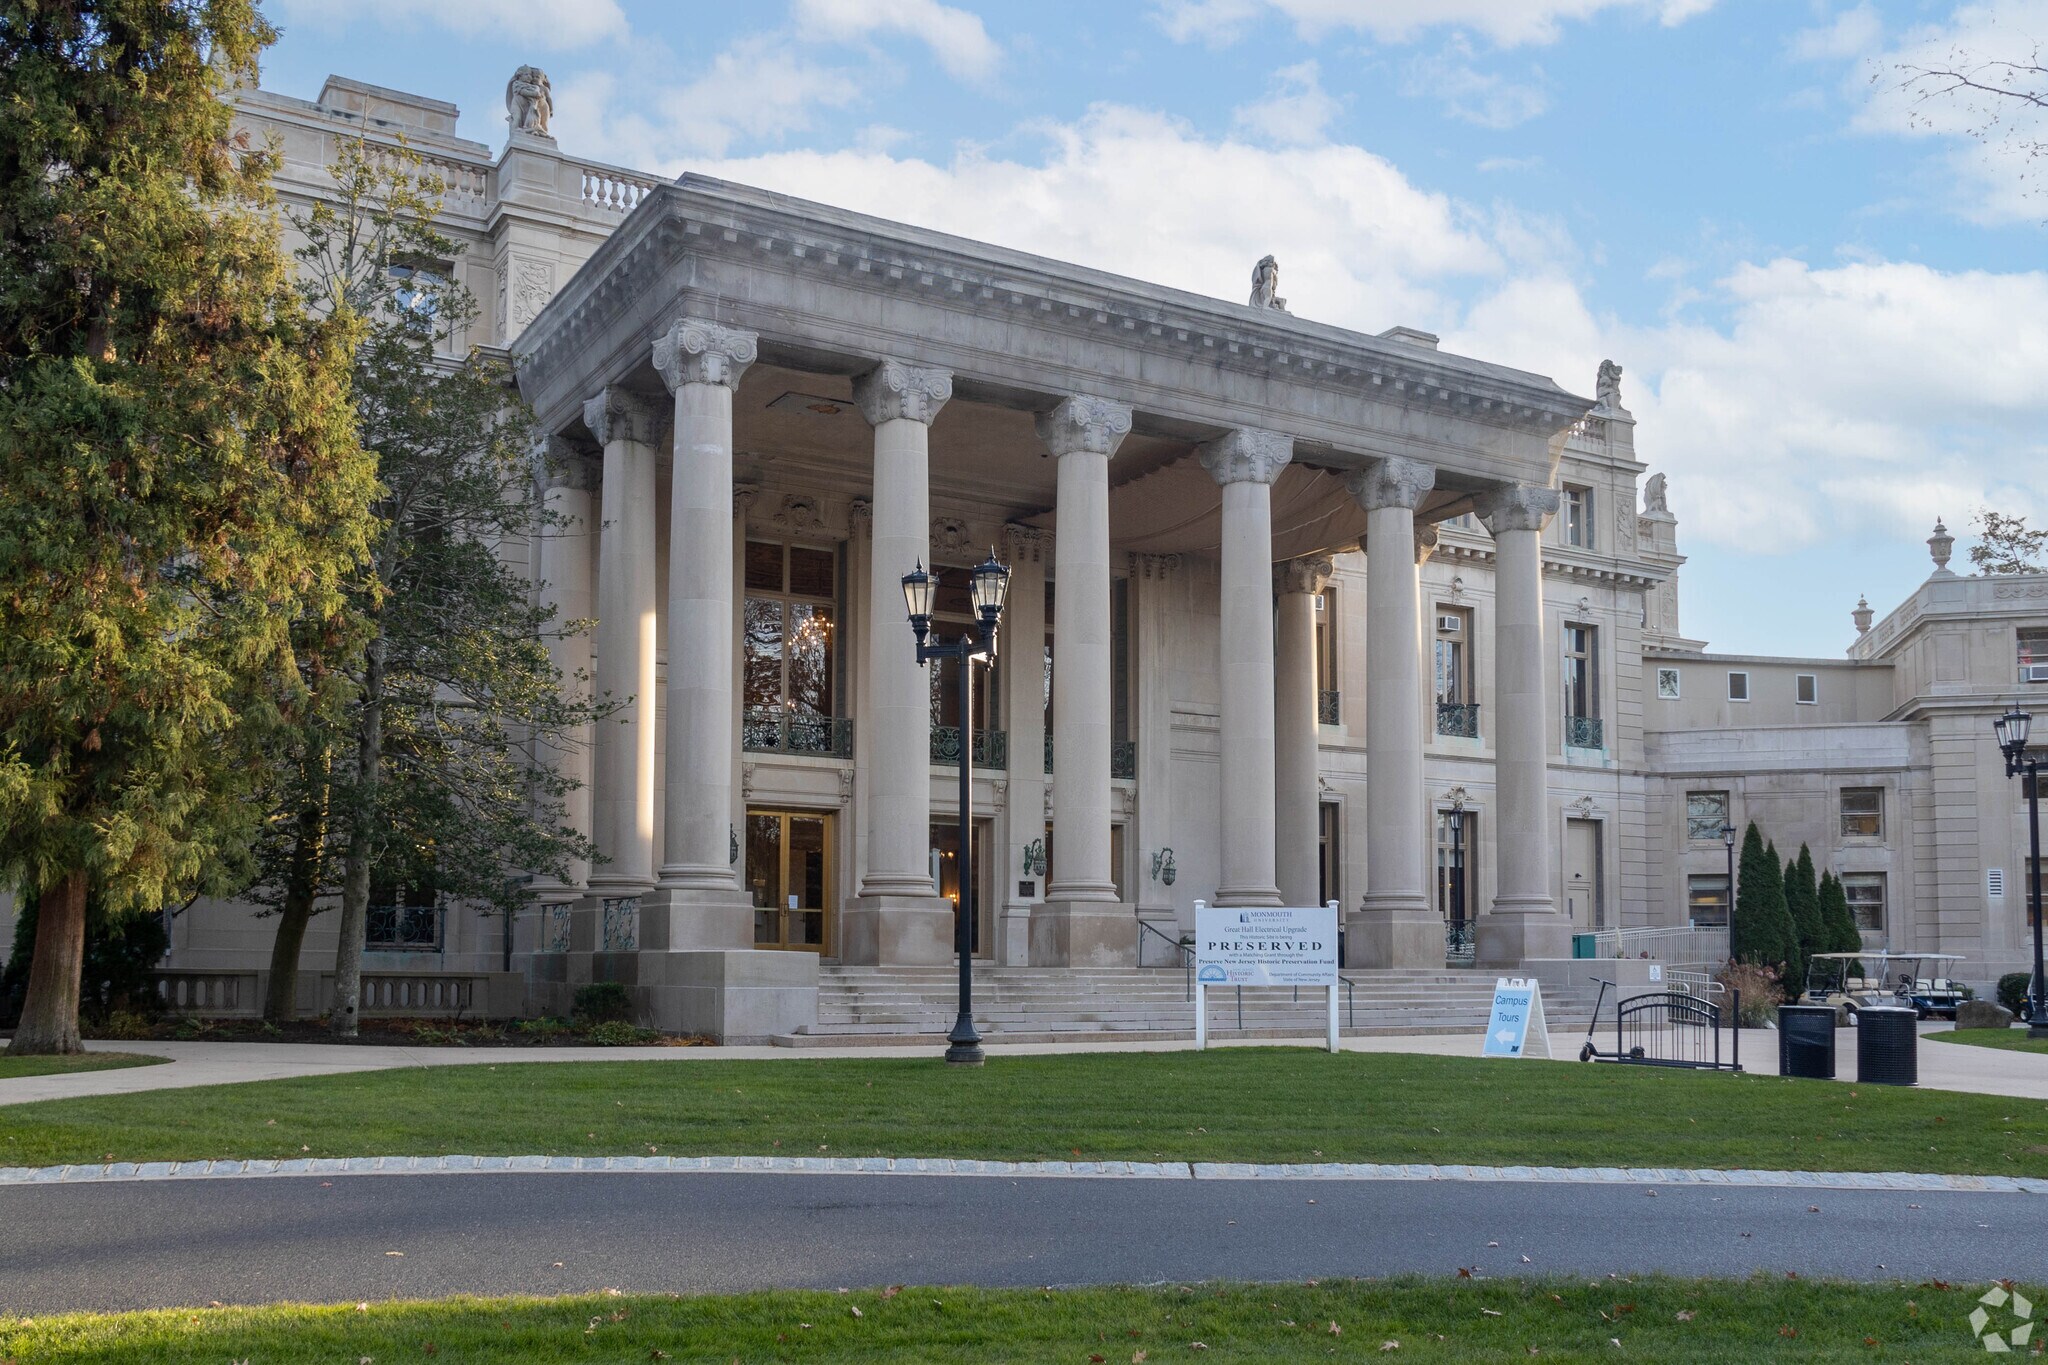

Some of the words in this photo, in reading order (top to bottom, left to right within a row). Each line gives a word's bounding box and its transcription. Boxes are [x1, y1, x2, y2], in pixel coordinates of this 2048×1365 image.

[1283, 926, 1307, 934] Upgrade
[1208, 942, 1322, 950] PRESERVED
[1496, 995, 1528, 1006] Campus
[1498, 1012, 1520, 1022] Tours
